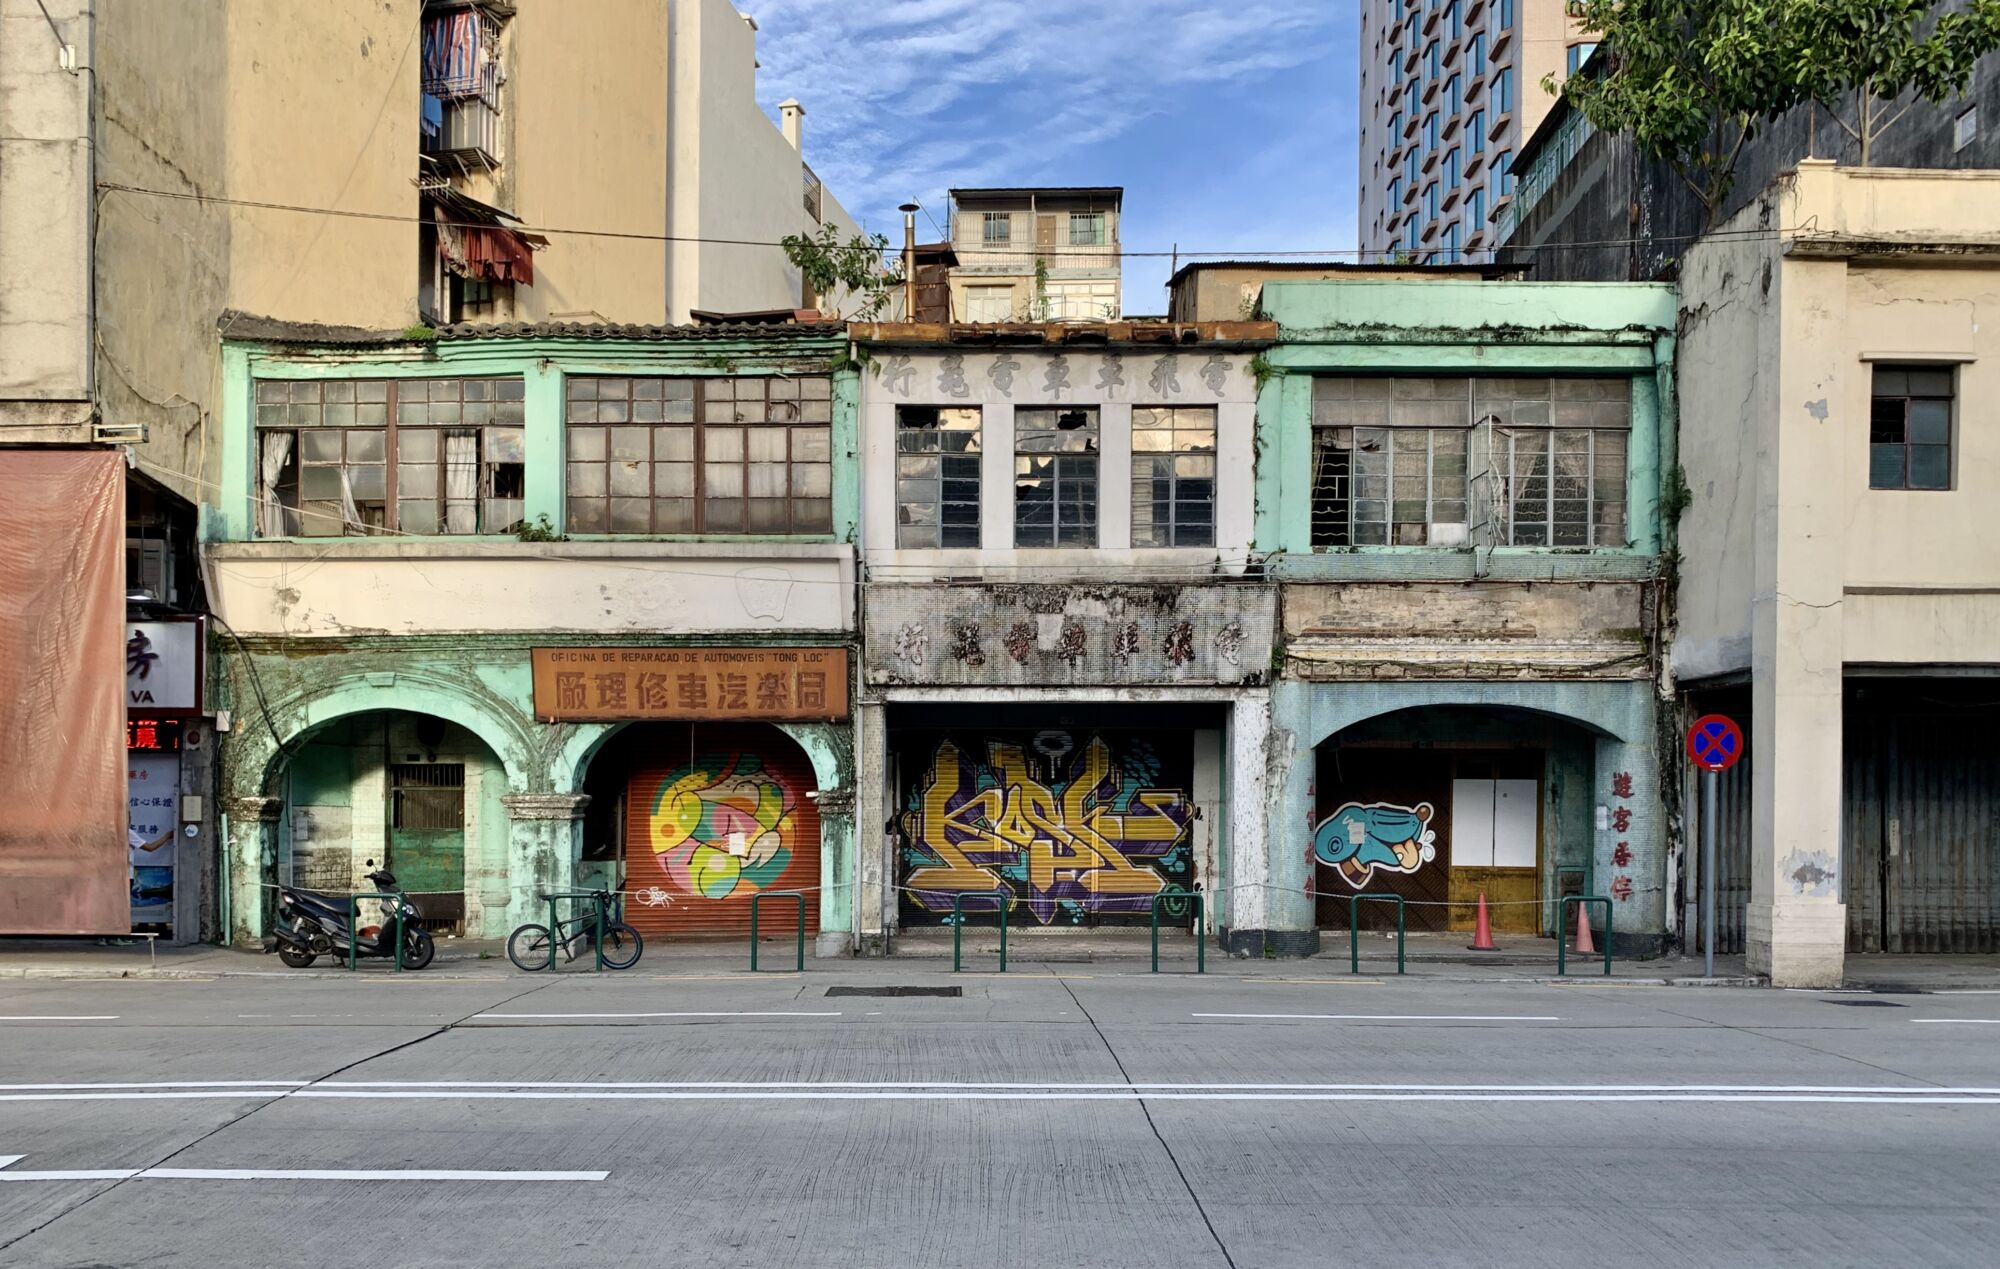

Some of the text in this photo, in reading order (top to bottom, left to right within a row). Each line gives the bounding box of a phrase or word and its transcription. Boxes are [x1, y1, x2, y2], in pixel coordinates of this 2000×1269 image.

[551, 652, 597, 662] OFICINA
[602, 652, 615, 662] DE
[685, 652, 698, 663] DE
